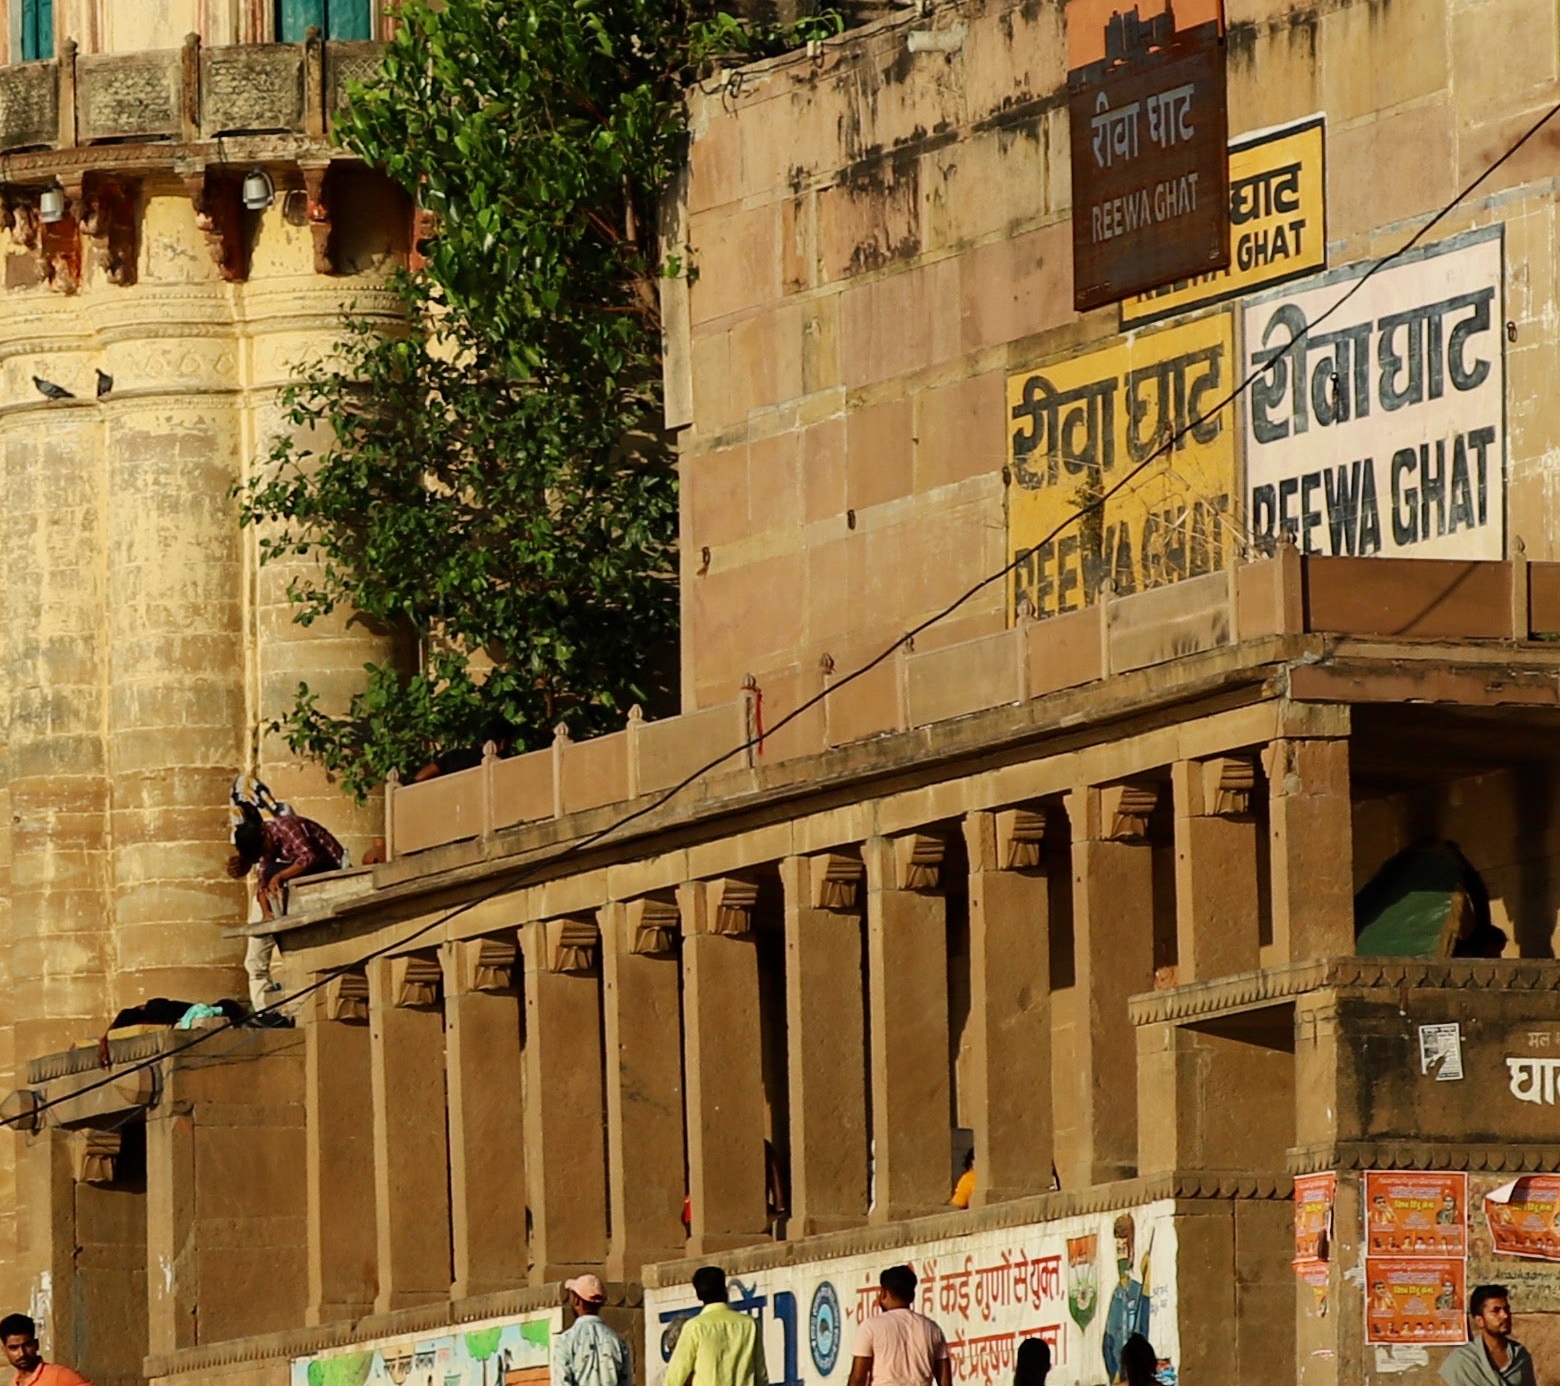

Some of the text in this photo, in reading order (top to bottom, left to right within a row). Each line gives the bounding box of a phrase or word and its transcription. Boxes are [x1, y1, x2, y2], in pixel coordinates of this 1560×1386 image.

[1091, 83, 1195, 168] रीवा घाट
[1091, 173, 1199, 243] REEWA GHAT
[1230, 162, 1302, 226] घाट
[1237, 219, 1306, 272] GHAT
[1251, 285, 1496, 445] रीवा घाट
[1012, 341, 1225, 490] रीवा घाट
[1253, 425, 1496, 558] REEWA GHAT
[940, 1254, 973, 1322] कई
[975, 1248, 1013, 1322] गुणों
[1014, 1248, 1029, 1303] से
